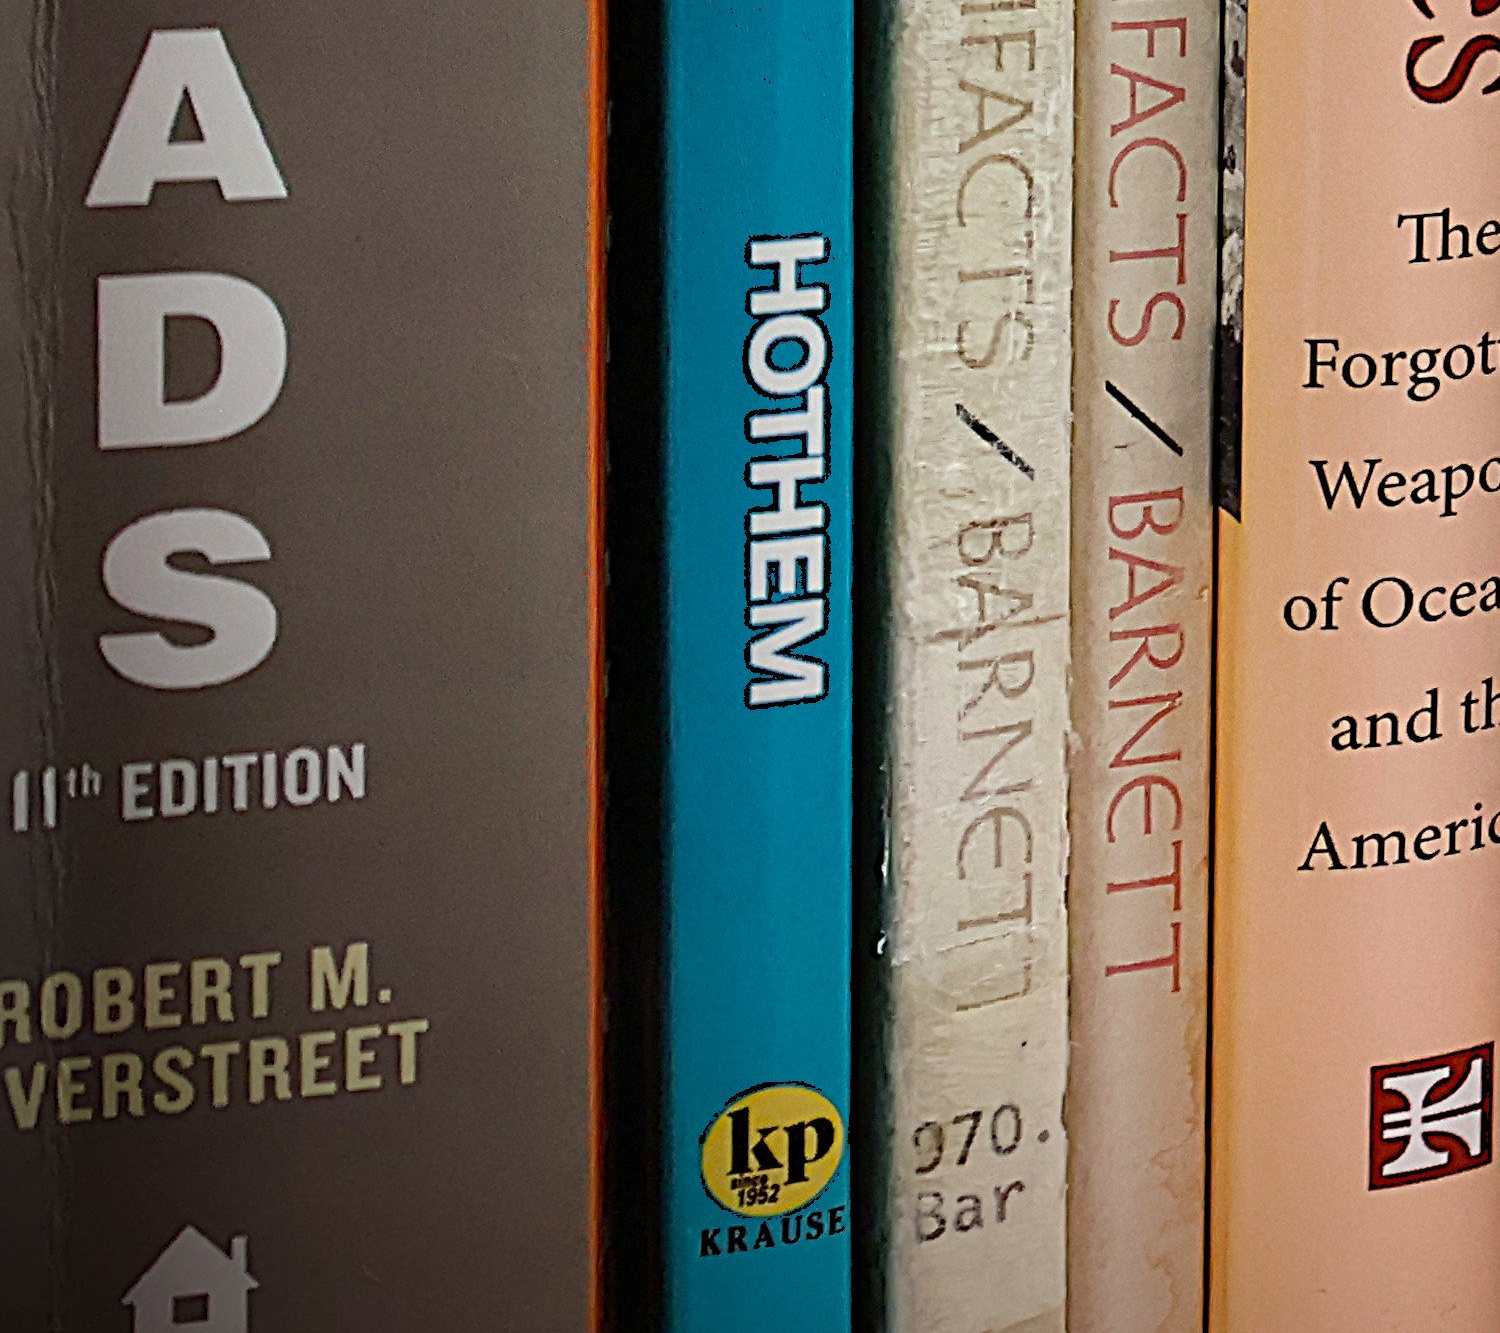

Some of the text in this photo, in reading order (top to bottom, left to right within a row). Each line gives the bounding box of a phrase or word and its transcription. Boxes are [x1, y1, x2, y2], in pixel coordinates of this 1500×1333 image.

[745, 233, 830, 708] HOTHEM
[1283, 575, 1349, 632] of
[1330, 687, 1443, 752] and
[121, 743, 367, 821] EDITION
[0, 943, 392, 1046] ROBERT M.
[727, 1107, 836, 1186] kp
[737, 1183, 781, 1208] 1952
[912, 1176, 1025, 1243] Bar
[700, 1205, 846, 1258] KRAUSE
